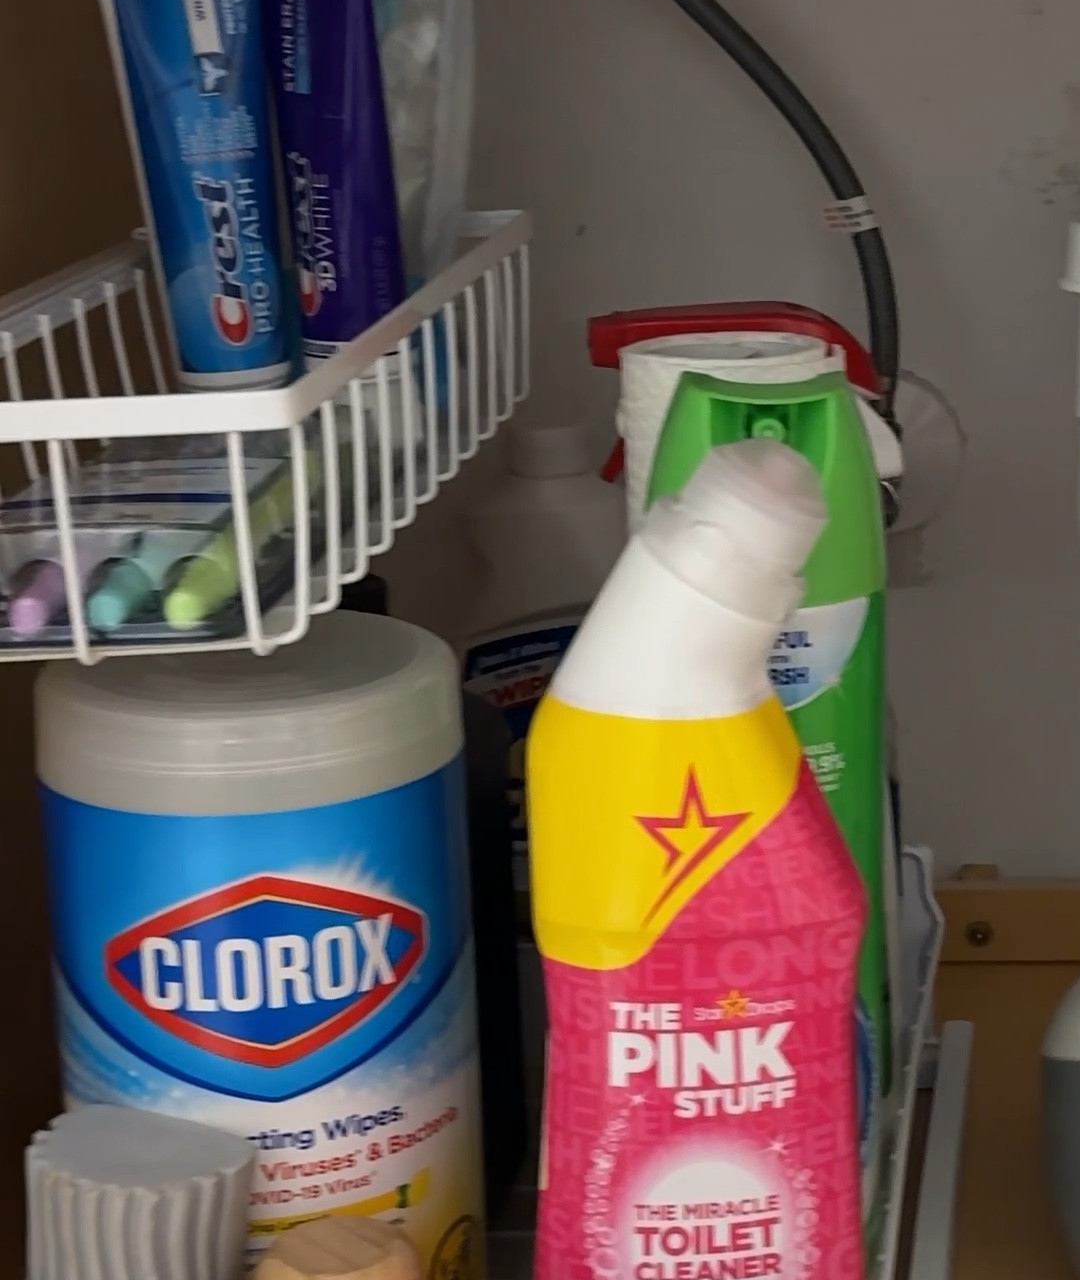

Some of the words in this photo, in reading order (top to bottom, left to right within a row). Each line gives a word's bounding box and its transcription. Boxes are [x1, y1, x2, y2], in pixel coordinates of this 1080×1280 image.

[281, 31, 298, 93] STAIN
[191, 173, 255, 346] Crest
[138, 912, 398, 1013] CLOROX
[609, 1001, 682, 1030] THE
[607, 1020, 796, 1088] PINK
[673, 1078, 797, 1119] STUFF
[321, 1106, 405, 1141] Wipes
[366, 1142, 385, 1161] &
[635, 1204, 677, 1221] THE
[682, 1194, 781, 1221] MIRACLE
[634, 1217, 783, 1257] TOILET
